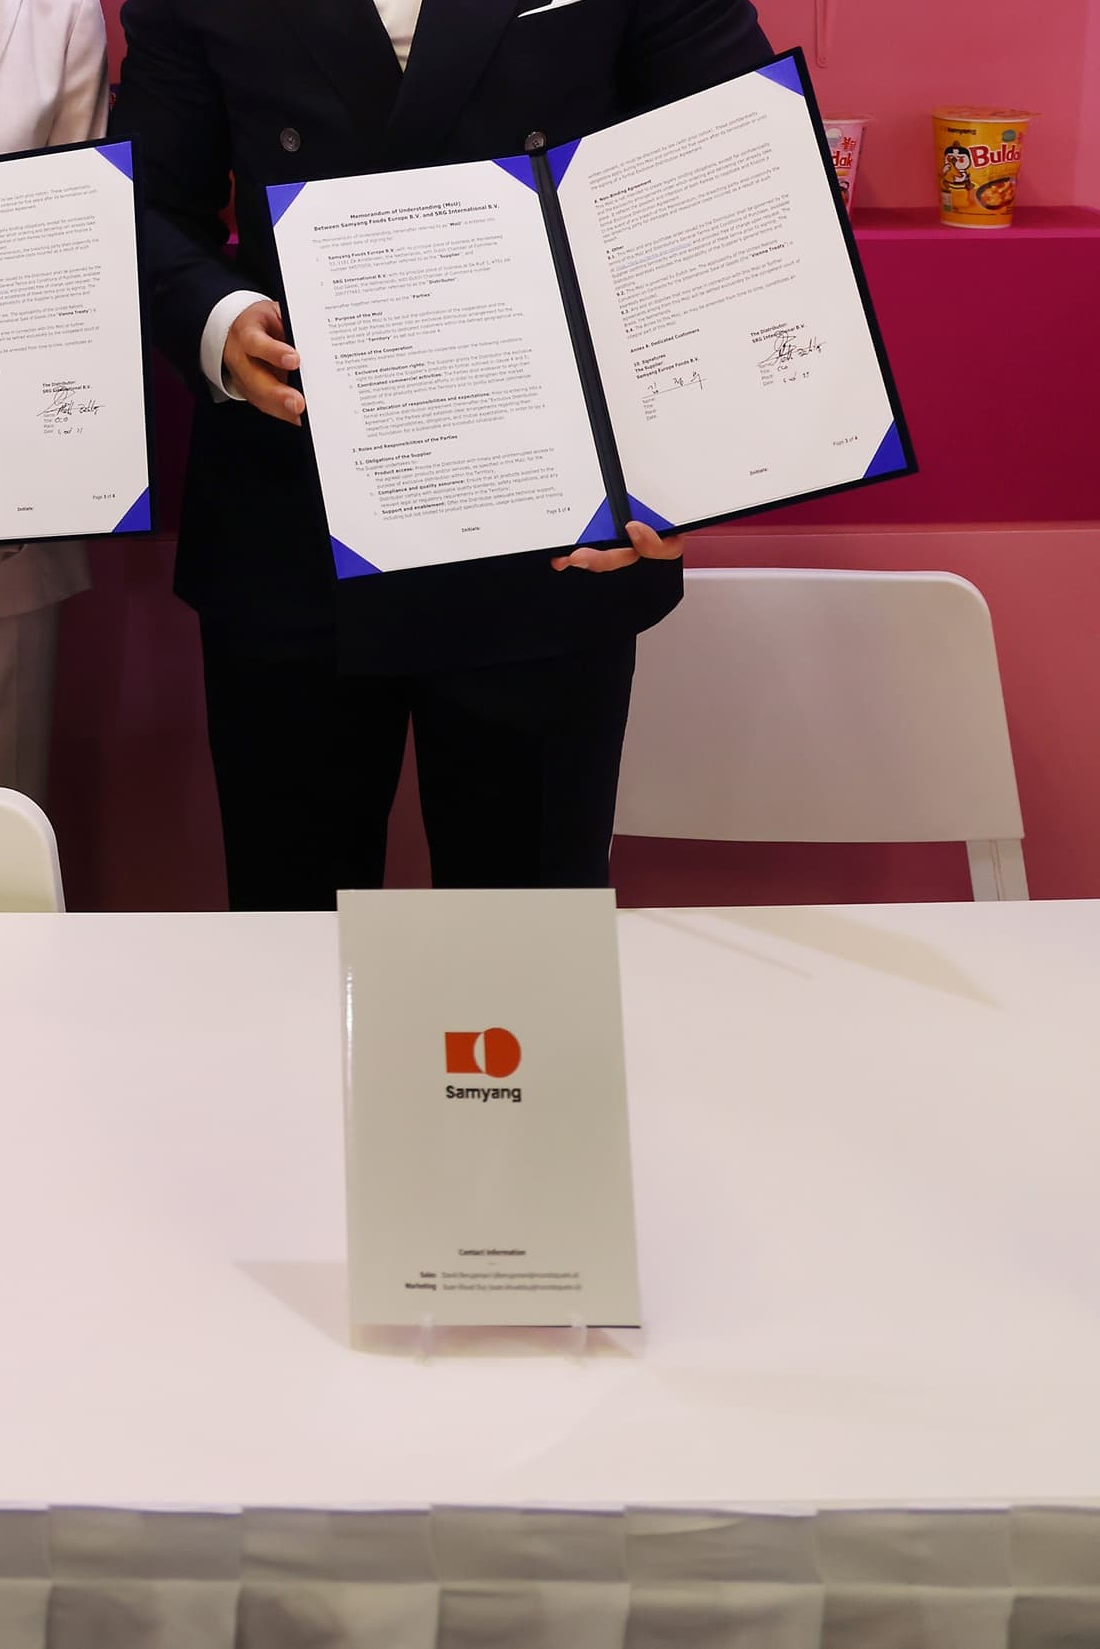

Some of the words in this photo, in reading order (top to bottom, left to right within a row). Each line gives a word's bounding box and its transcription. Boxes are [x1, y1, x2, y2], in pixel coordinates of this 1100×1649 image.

[314, 223, 339, 231] Between
[341, 220, 367, 228] Samyang
[388, 215, 408, 223] Europe
[448, 206, 487, 215] International
[350, 210, 390, 218] Memorandum
[399, 204, 441, 214] Understanding
[445, 1085, 522, 1103] Samyang
